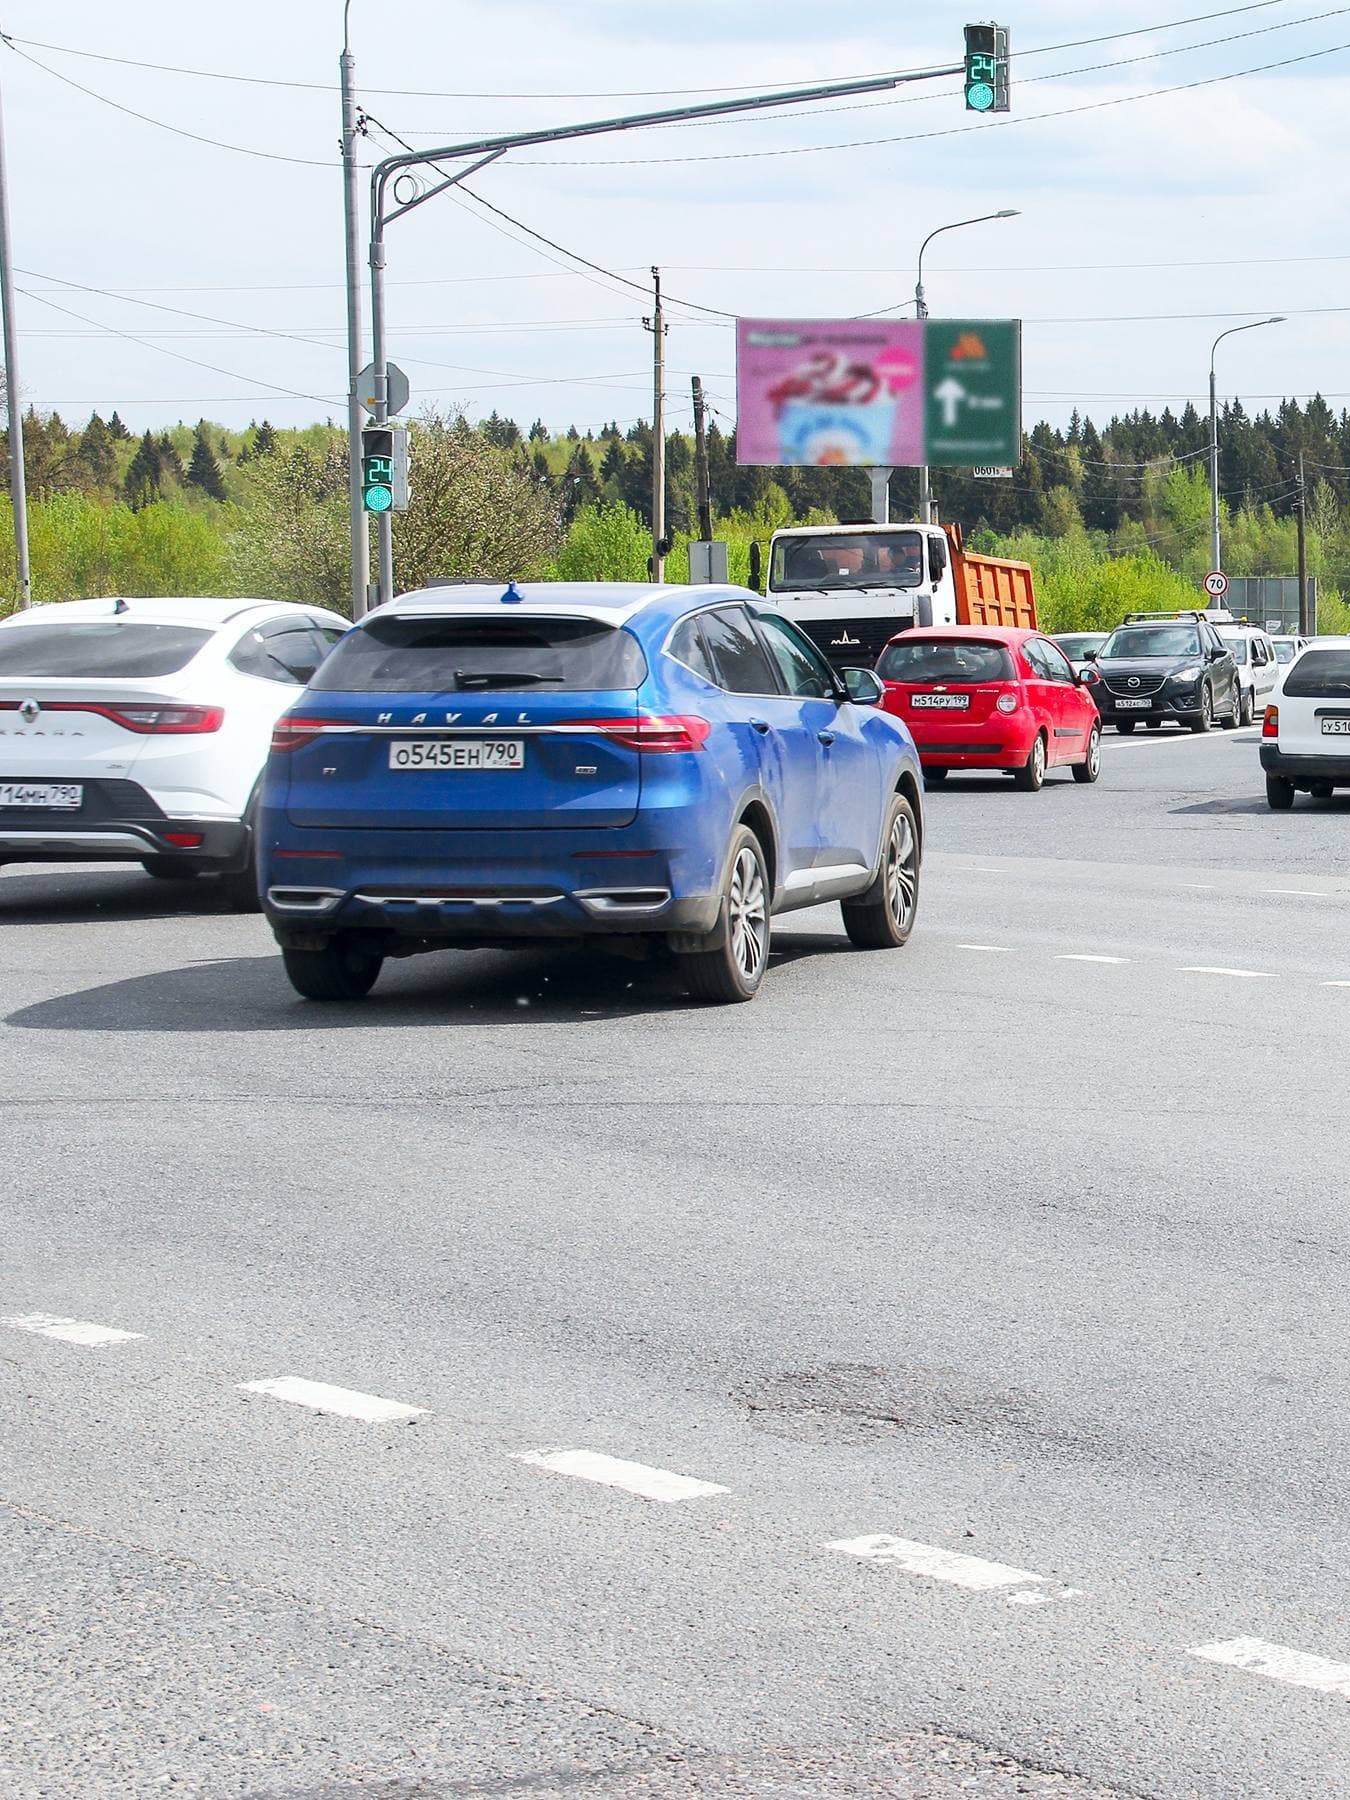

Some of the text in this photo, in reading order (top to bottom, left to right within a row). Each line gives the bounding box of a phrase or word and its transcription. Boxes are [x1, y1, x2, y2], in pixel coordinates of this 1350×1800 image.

[971, 55, 993, 79] 24
[369, 459, 392, 481] 24
[1210, 579, 1224, 589] 70
[953, 695, 967, 704] 199
[377, 712, 531, 724] HAVAL
[485, 743, 517, 760] 790
